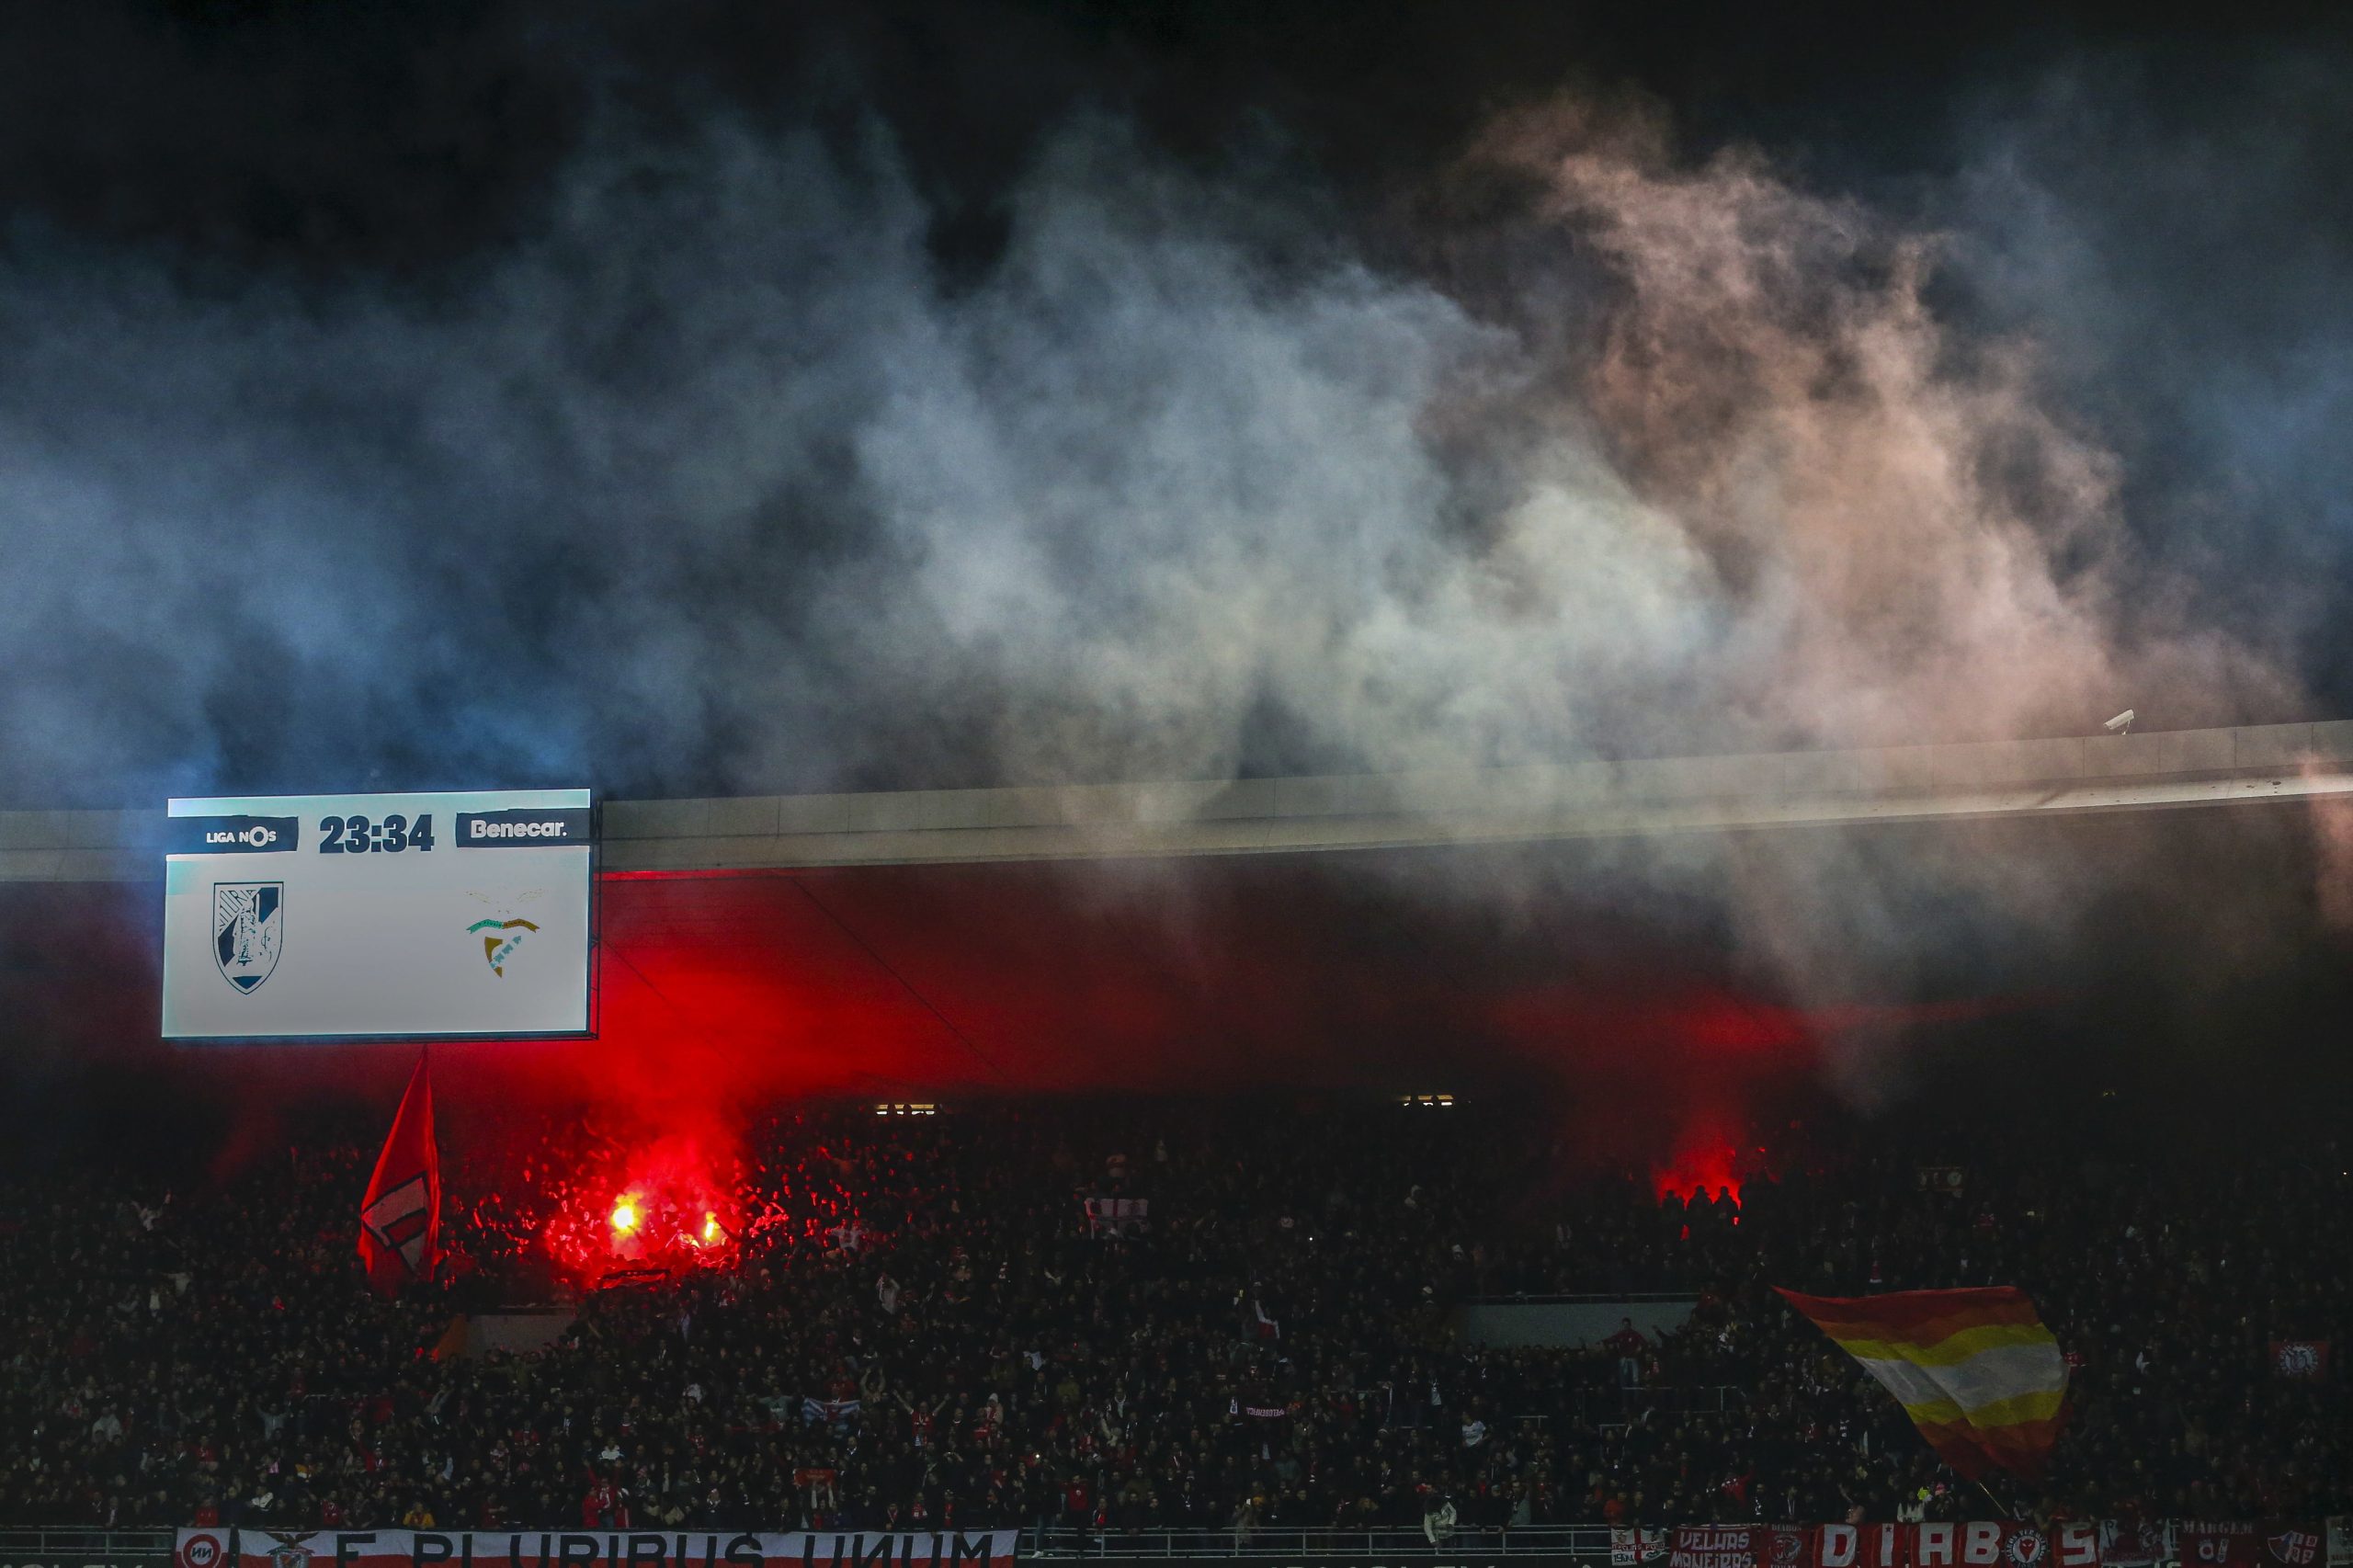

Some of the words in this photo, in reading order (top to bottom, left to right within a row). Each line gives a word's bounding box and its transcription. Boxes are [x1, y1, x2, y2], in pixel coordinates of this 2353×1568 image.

[206, 832, 235, 843] LIGA
[239, 825, 277, 847] NOS
[319, 814, 435, 853] 23:34
[471, 820, 567, 838] Benecar.
